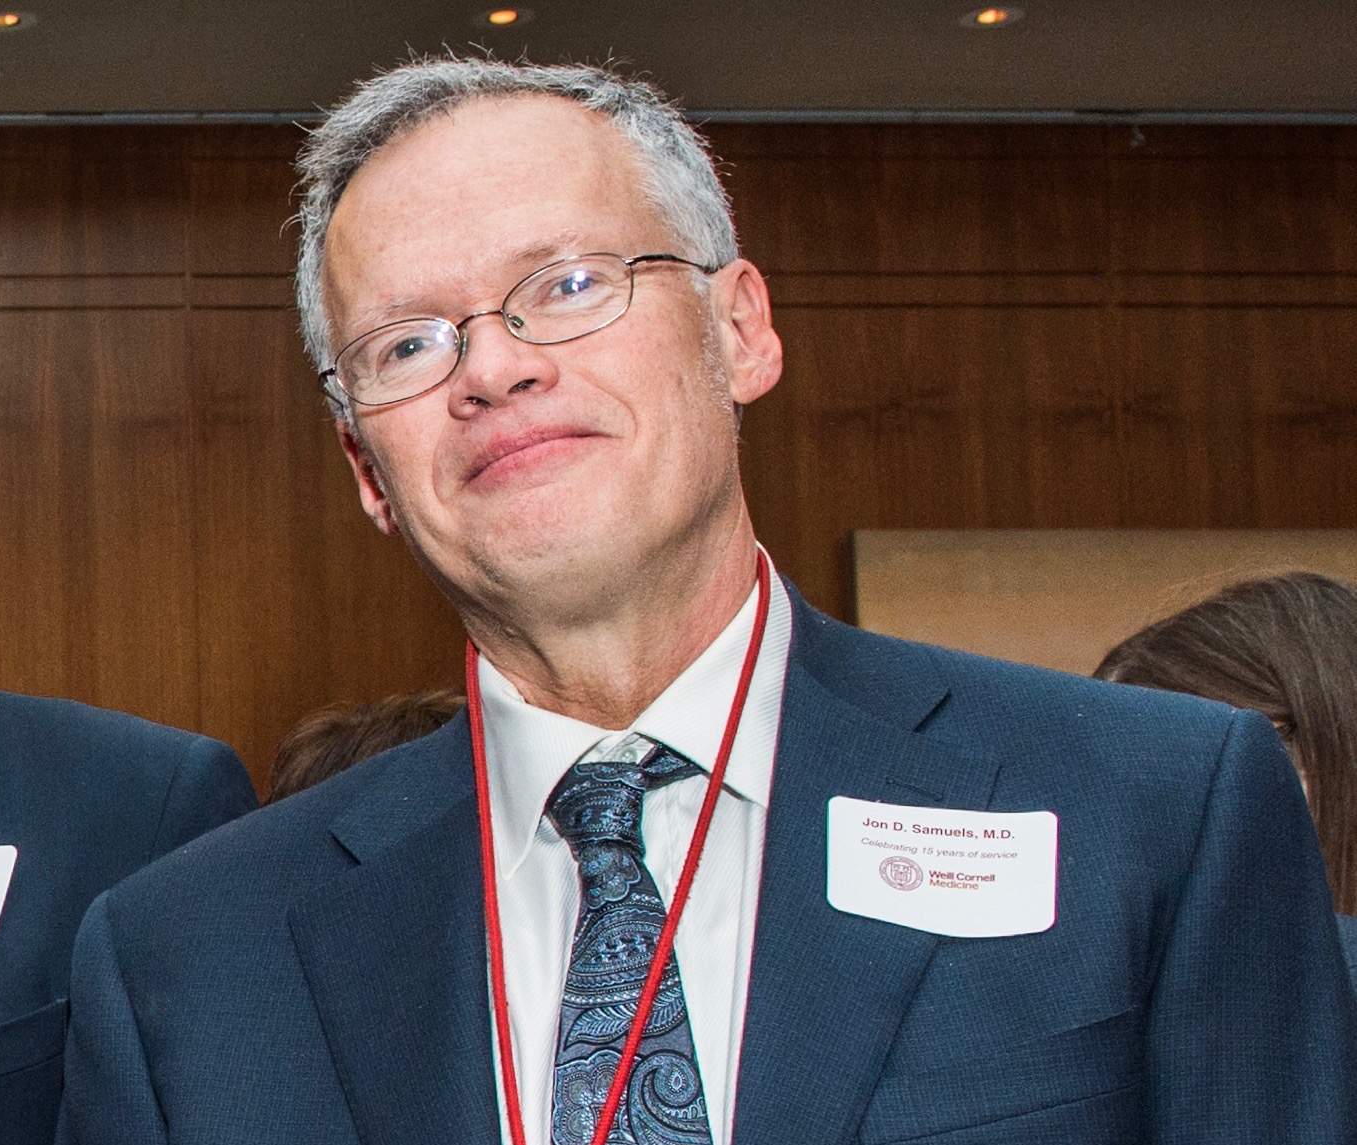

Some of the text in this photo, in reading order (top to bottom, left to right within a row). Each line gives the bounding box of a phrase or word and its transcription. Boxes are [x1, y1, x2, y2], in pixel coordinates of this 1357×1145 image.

[862, 817, 1015, 840] Jon D. Samuels, M.D.
[861, 837, 1018, 860] Celebrating 15 years of service
[928, 870, 995, 883] Weill Cornell
[928, 879, 979, 890] Medicine
